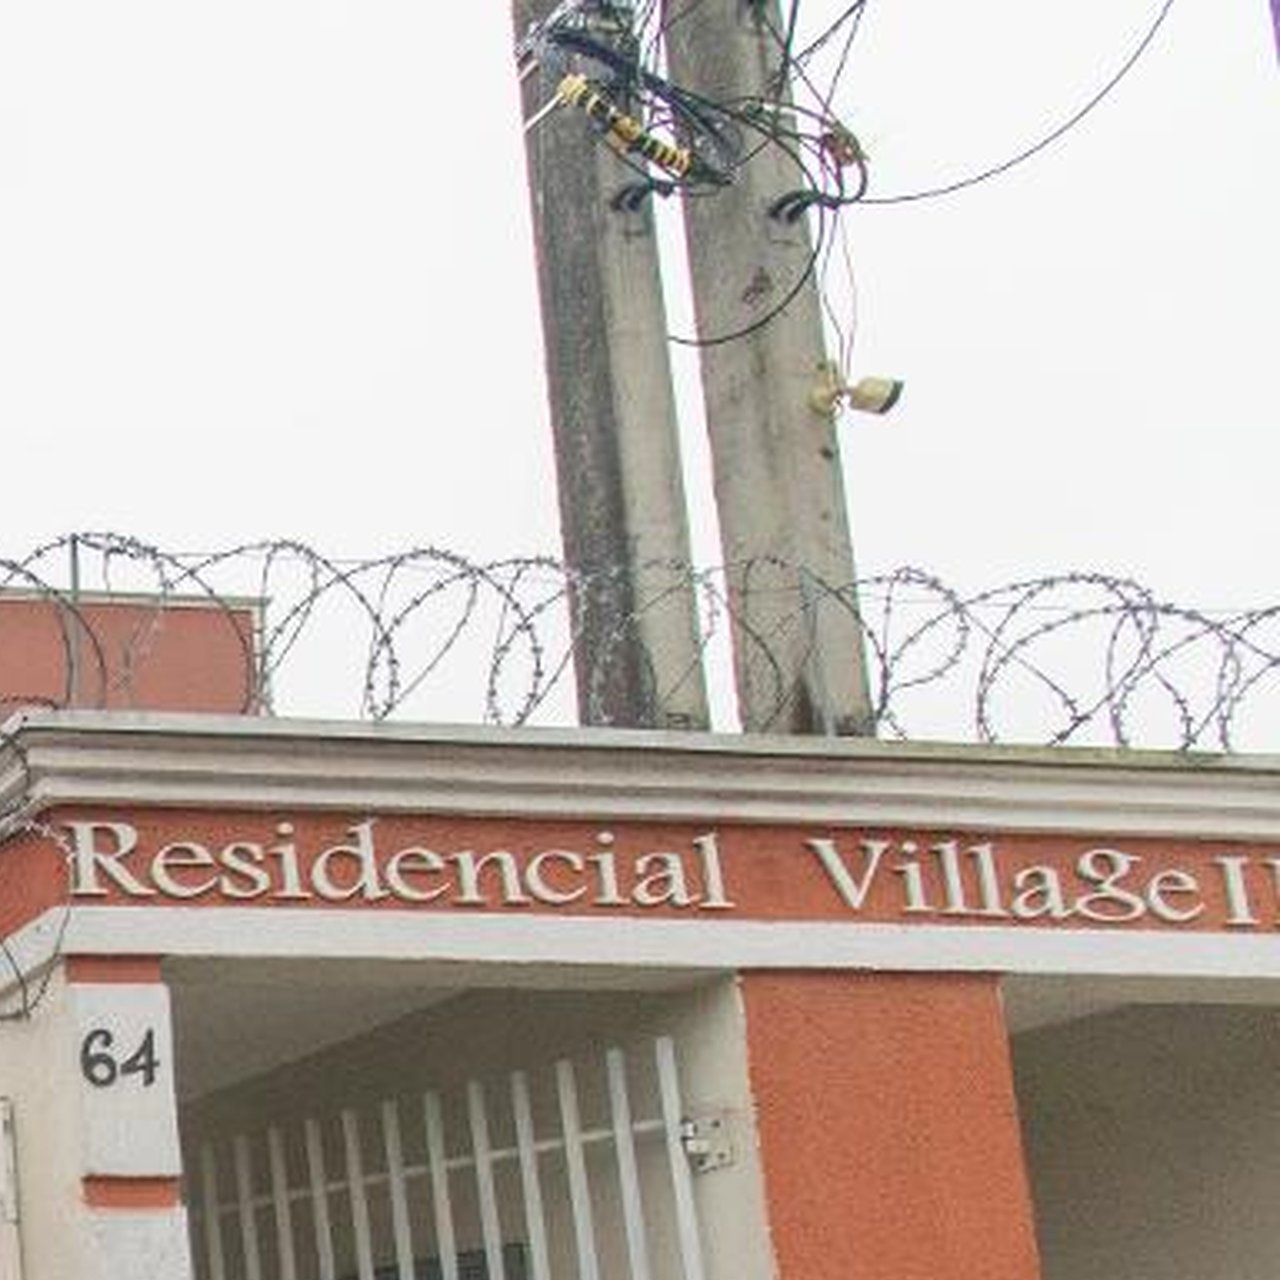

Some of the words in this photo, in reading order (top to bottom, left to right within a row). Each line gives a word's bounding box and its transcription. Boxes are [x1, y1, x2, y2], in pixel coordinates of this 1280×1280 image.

[62, 817, 738, 911] Residencial
[804, 837, 1206, 923] Village
[80, 1027, 161, 1088] 64
